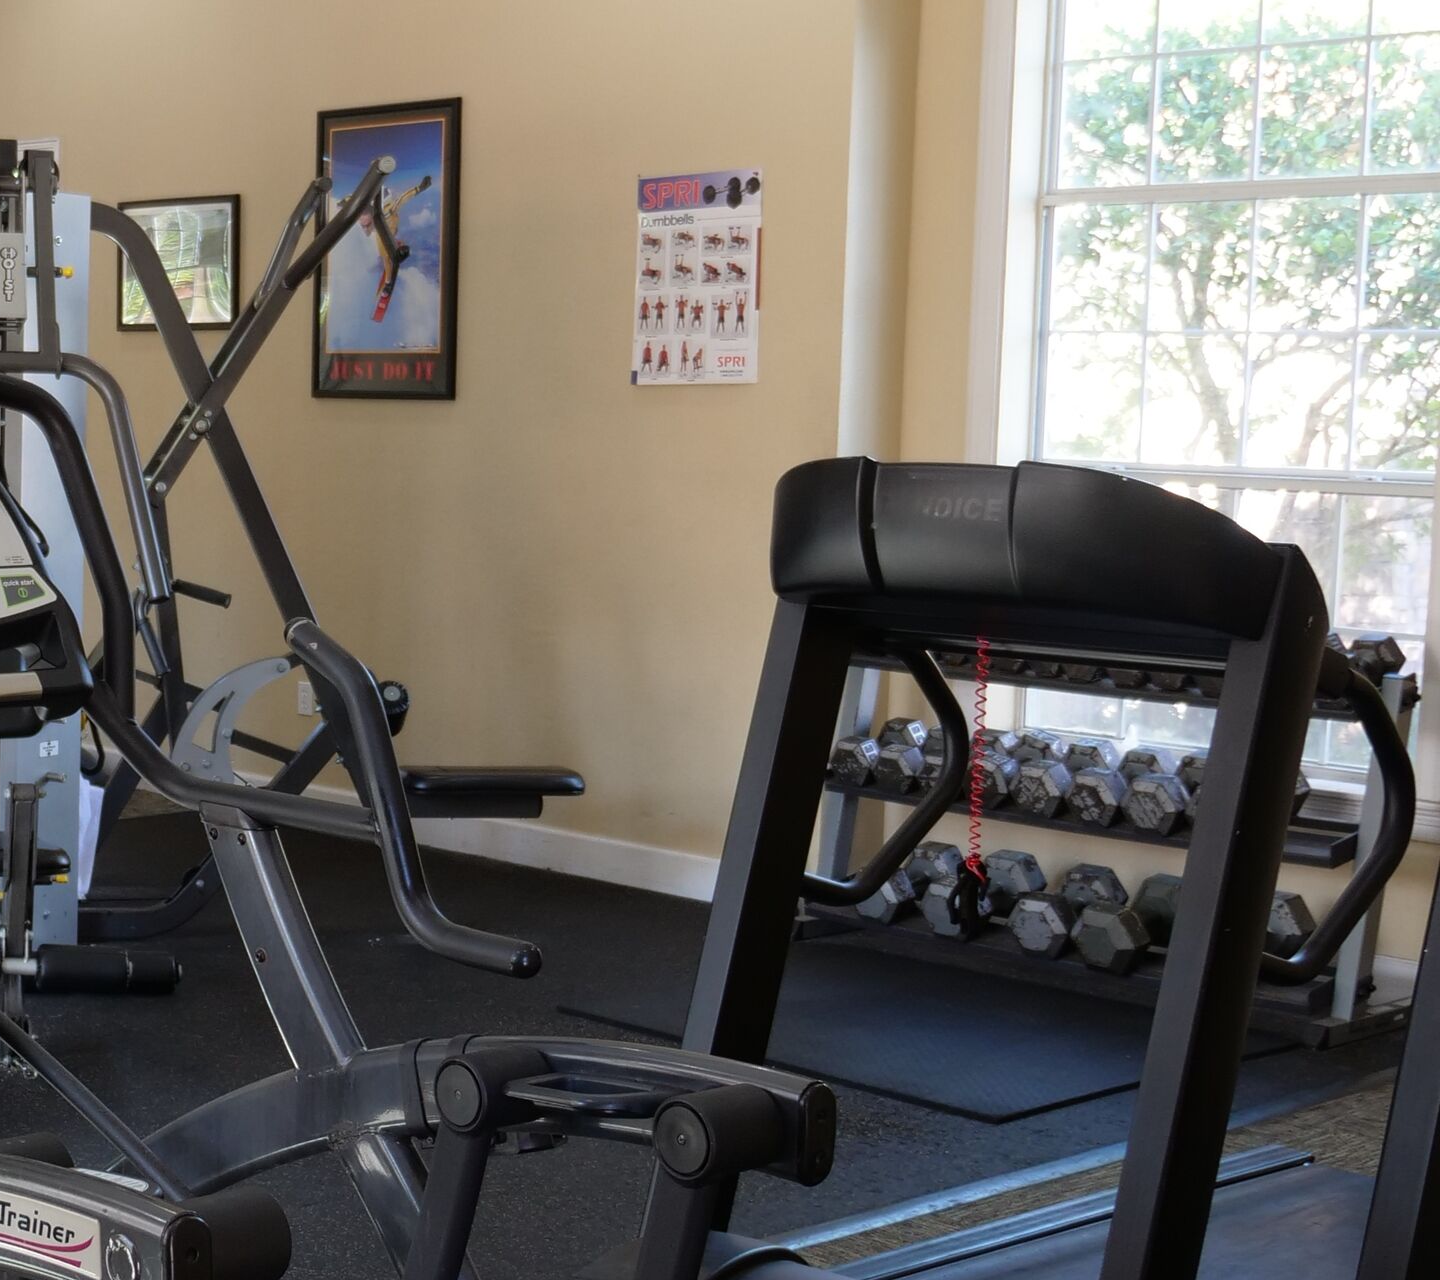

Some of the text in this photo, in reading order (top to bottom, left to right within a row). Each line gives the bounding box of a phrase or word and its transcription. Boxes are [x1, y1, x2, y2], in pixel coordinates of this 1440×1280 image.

[642, 179, 700, 209] SPRI
[641, 214, 694, 228] Dumbbells
[0, 247, 17, 302] HOIST
[717, 356, 745, 368] SPRI
